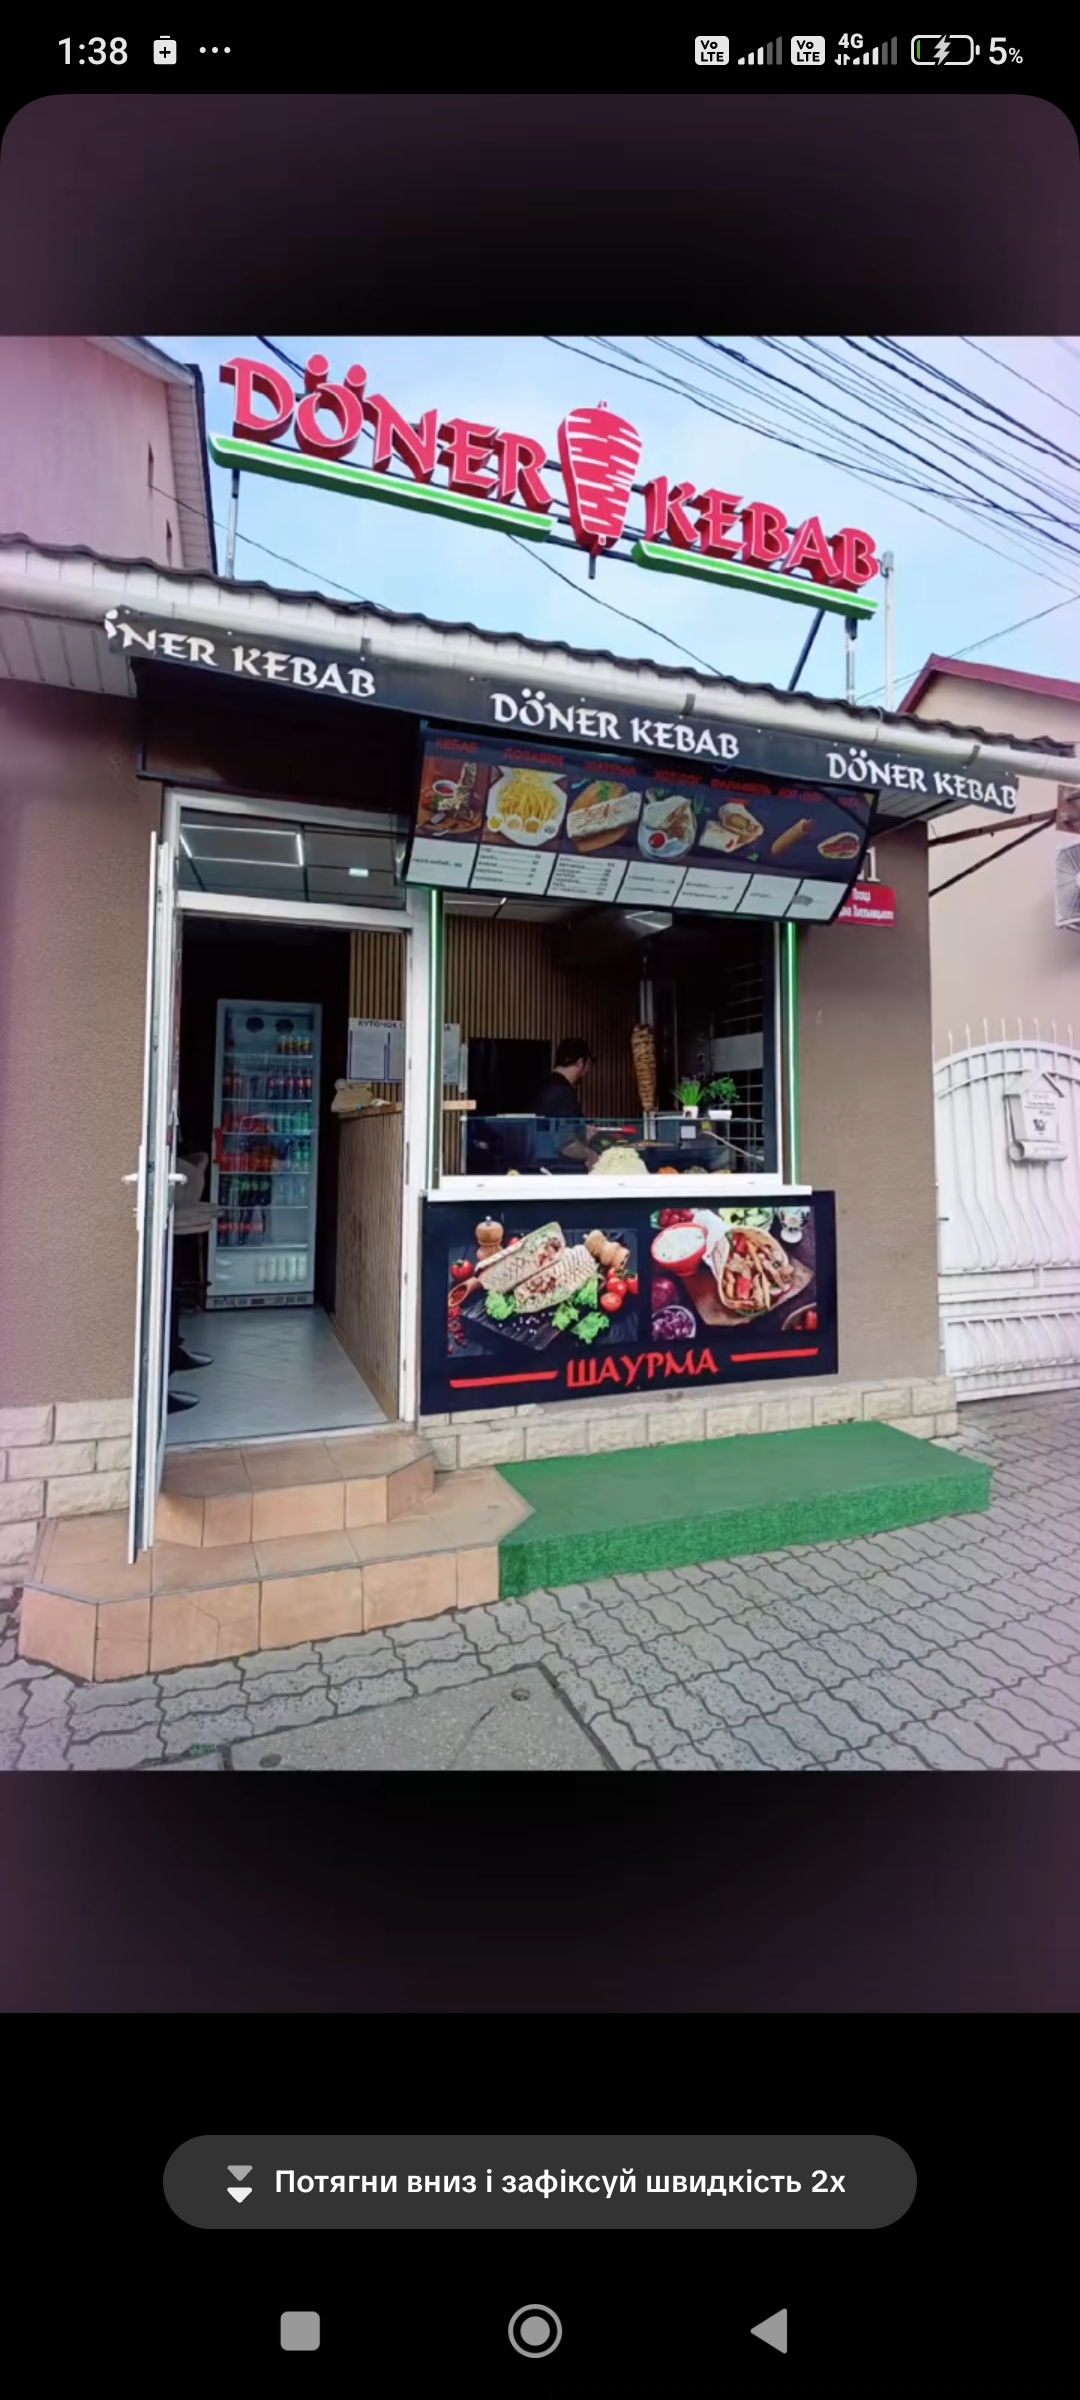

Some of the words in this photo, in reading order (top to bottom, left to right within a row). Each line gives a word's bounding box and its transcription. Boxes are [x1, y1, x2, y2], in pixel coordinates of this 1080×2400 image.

[219, 354, 552, 512] DÖNER
[641, 476, 880, 592] KEBAB
[232, 646, 376, 698] KEBAB
[490, 688, 621, 740] DÖNER
[630, 717, 740, 759] KEBAB
[826, 747, 928, 792] DÖNER
[933, 771, 1016, 809] KEBAB
[566, 1347, 720, 1387] ШАУРМА
